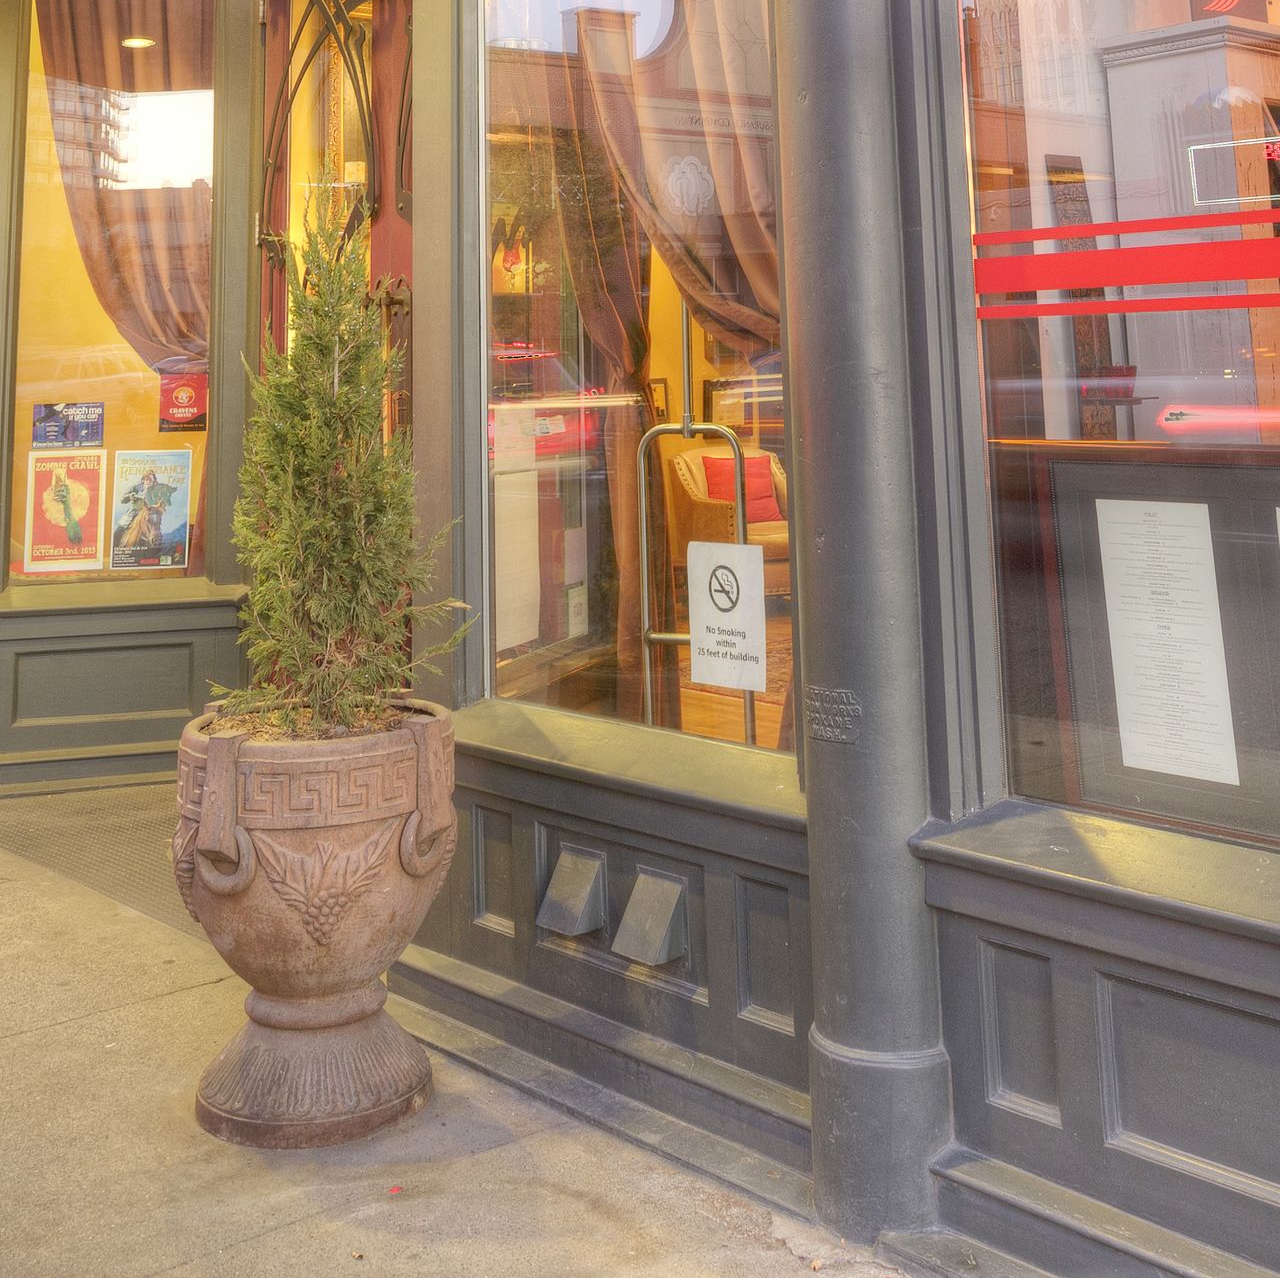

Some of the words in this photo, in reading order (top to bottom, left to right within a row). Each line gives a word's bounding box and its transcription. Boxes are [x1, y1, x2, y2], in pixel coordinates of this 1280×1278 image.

[62, 407, 88, 416] catch
[88, 407, 103, 415] me
[74, 414, 87, 422] you
[32, 548, 64, 556] OCTOBER
[706, 625, 716, 635] No
[717, 626, 746, 640] Smoking
[715, 639, 737, 649] within
[697, 647, 705, 656] 25
[706, 648, 721, 659] feet
[721, 651, 729, 659] of
[729, 651, 760, 664] building
[806, 688, 857, 704] ATIONAL
